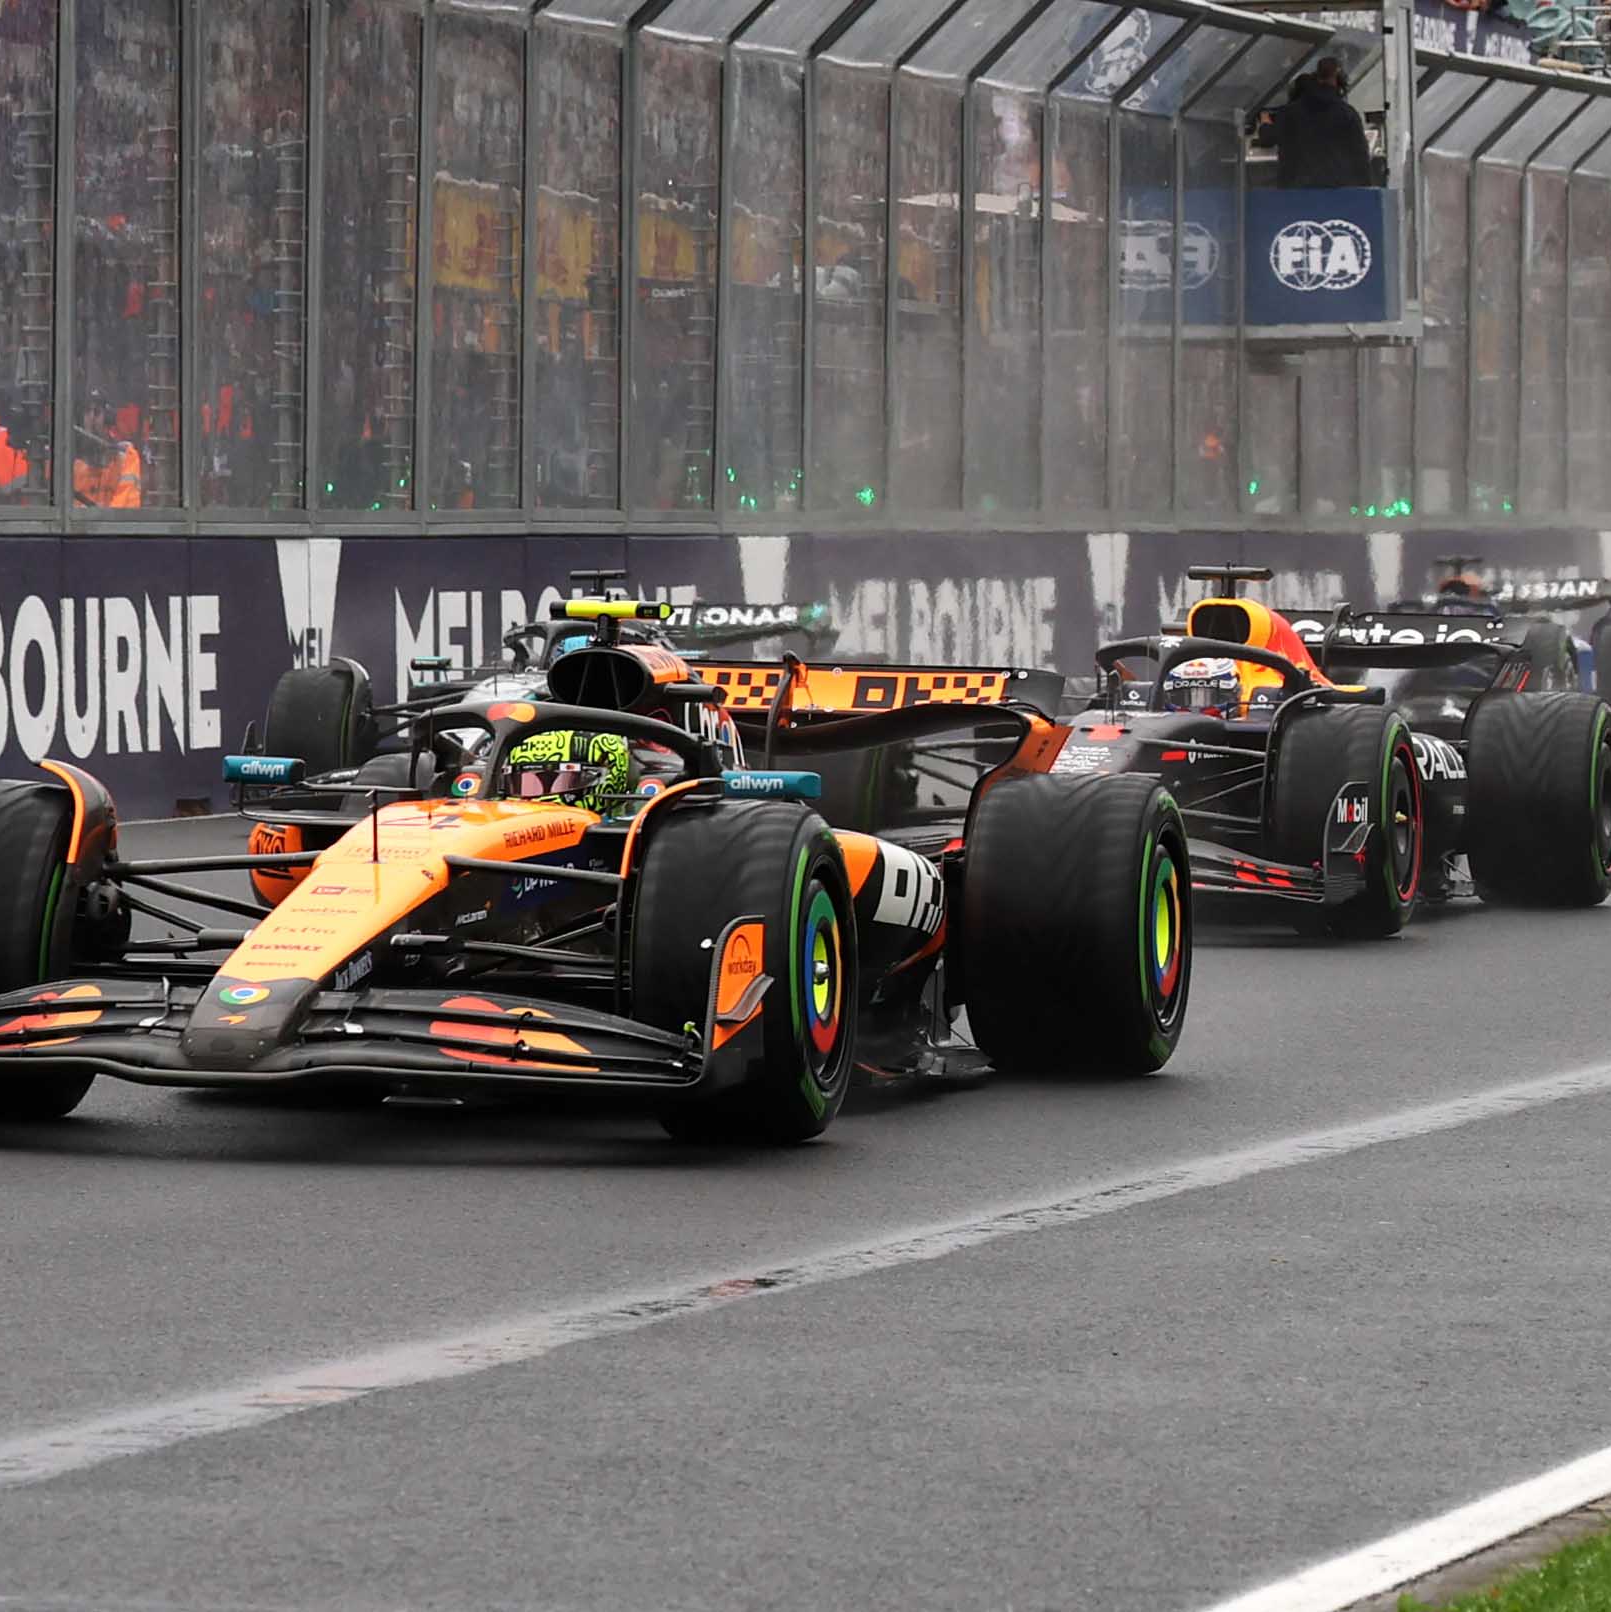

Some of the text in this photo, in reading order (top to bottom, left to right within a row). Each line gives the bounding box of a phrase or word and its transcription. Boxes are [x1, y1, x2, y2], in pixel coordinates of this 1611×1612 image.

[1174, 680, 1219, 689] ORACLE
[240, 759, 286, 778] allwyn
[729, 773, 785, 794] allwyn
[1337, 797, 1369, 824] Mobil
[503, 818, 576, 849] RICHARD MILLE
[455, 909, 488, 926] McLaren
